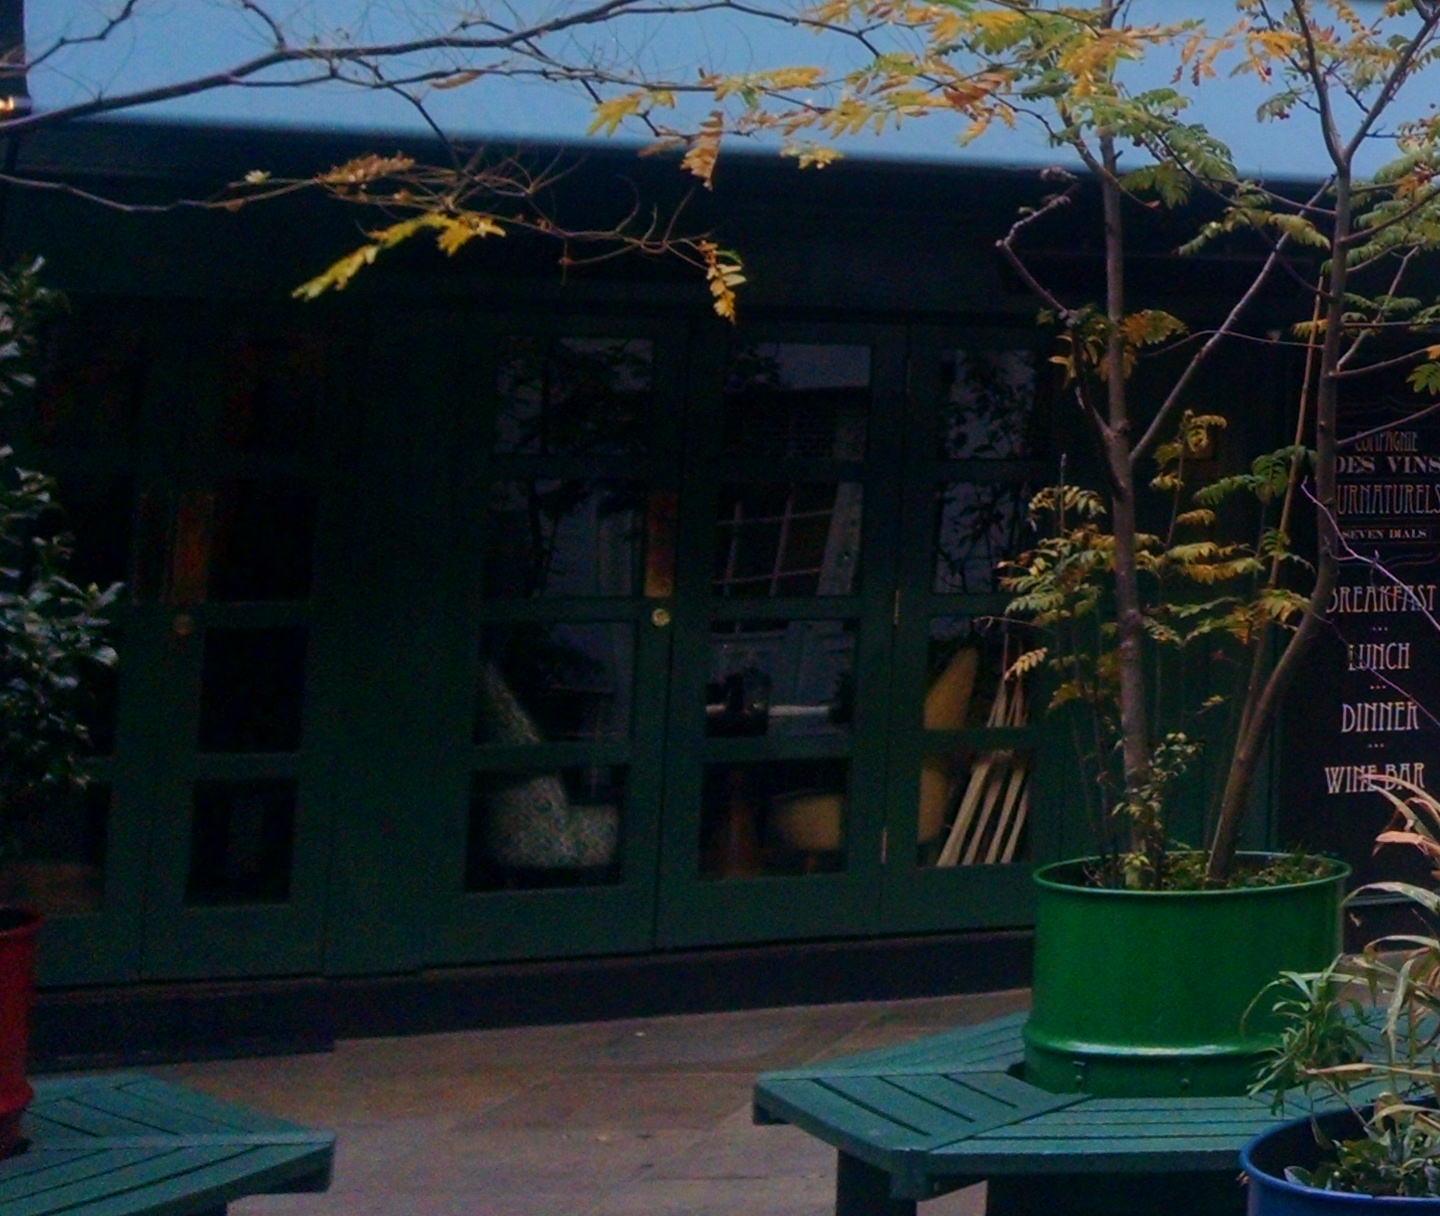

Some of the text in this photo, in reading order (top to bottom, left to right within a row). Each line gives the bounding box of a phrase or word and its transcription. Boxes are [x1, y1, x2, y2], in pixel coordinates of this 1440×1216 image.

[1342, 528, 1428, 540] SEVEN DIALS
[1347, 643, 1412, 671] LUNCH
[1341, 701, 1420, 733] DINNER
[1324, 763, 1425, 795] WINE BAR
